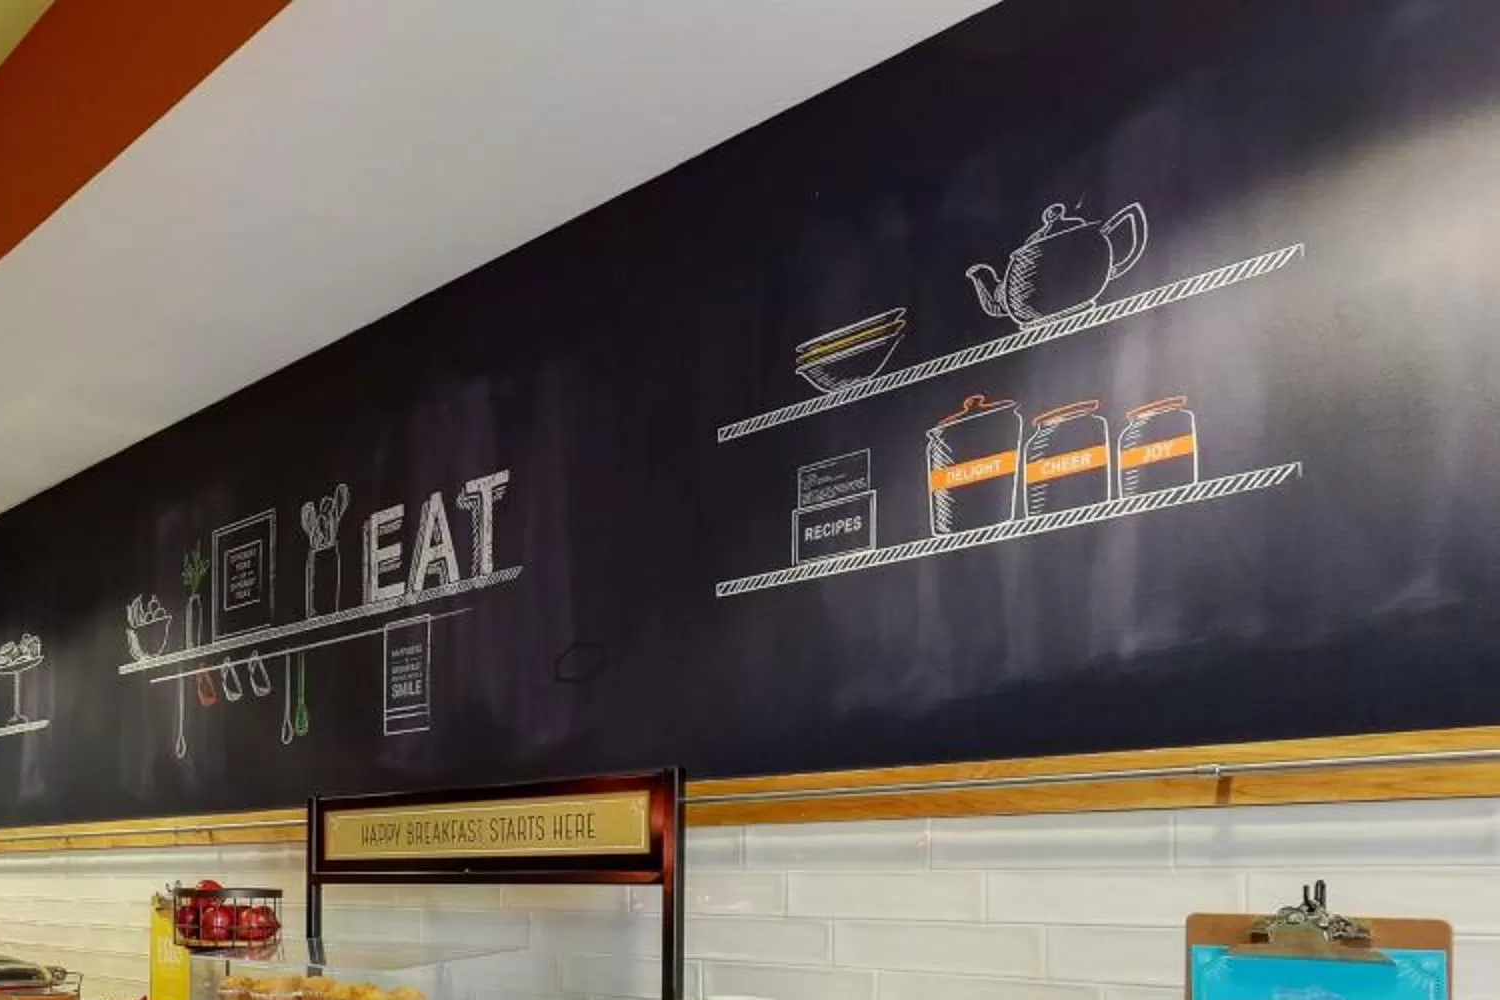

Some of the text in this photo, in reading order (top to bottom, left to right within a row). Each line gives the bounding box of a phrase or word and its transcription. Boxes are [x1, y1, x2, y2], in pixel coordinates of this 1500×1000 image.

[1041, 452, 1094, 476] CHEER
[1142, 442, 1173, 461] JOY
[946, 459, 1002, 484] DELIGHT
[362, 469, 510, 604] EAT
[804, 515, 862, 542] RECIPES
[361, 812, 597, 847] HAPPY BREAKFAST STARTS HERE
